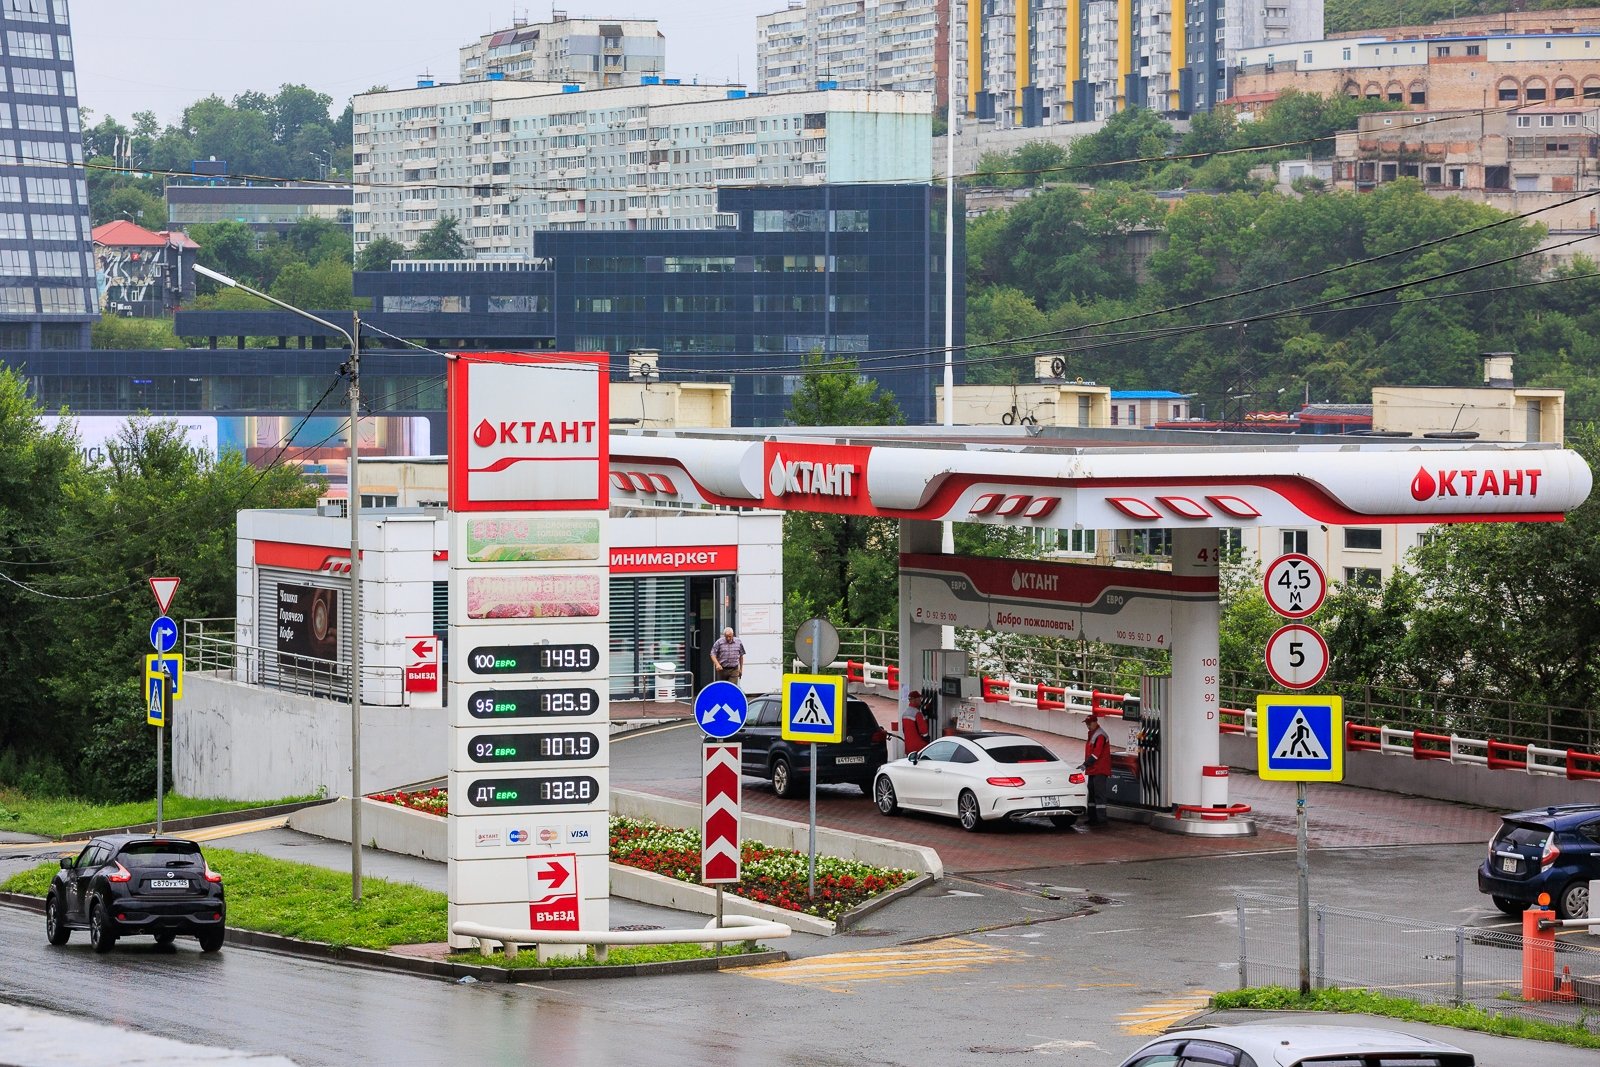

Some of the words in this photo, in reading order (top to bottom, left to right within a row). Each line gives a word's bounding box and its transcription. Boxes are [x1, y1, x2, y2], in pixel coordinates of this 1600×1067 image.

[1197, 548, 1209, 562] 4
[951, 581, 967, 591] ЕВРО
[1277, 569, 1311, 592] 4,5
[1106, 595, 1124, 606] ЕВРО
[279, 608, 304, 623] Горячего
[916, 607, 923, 618] 2
[997, 611, 1022, 628] Добро
[1024, 617, 1075, 632] пожаловать!
[280, 626, 294, 642] Кофе
[1116, 630, 1127, 640] 100
[1128, 632, 1136, 641] 95
[1137, 633, 1145, 642] 92
[1157, 634, 1164, 646] 4
[475, 654, 495, 668] 100
[495, 659, 516, 668] ЕВРО
[545, 649, 590, 667] 149.9
[1289, 642, 1305, 667] 5
[1202, 658, 1217, 667] 100
[408, 672, 436, 681] ВЫЕЗД
[1204, 676, 1216, 685] 95
[476, 699, 494, 713] 95
[495, 703, 516, 712] ЕВРО
[545, 693, 590, 711] 125.9
[1204, 693, 1215, 702] 92
[1206, 711, 1214, 720] D
[476, 743, 493, 757] 92
[495, 748, 516, 756] ЕВРО
[545, 737, 590, 755] 107.9
[476, 786, 496, 802] ДТ
[496, 791, 517, 800] ЕВРО
[545, 780, 590, 799] 132.8
[1111, 784, 1118, 794] 4
[571, 830, 589, 838] VISA
[536, 910, 576, 922] ВЪЕЗД
